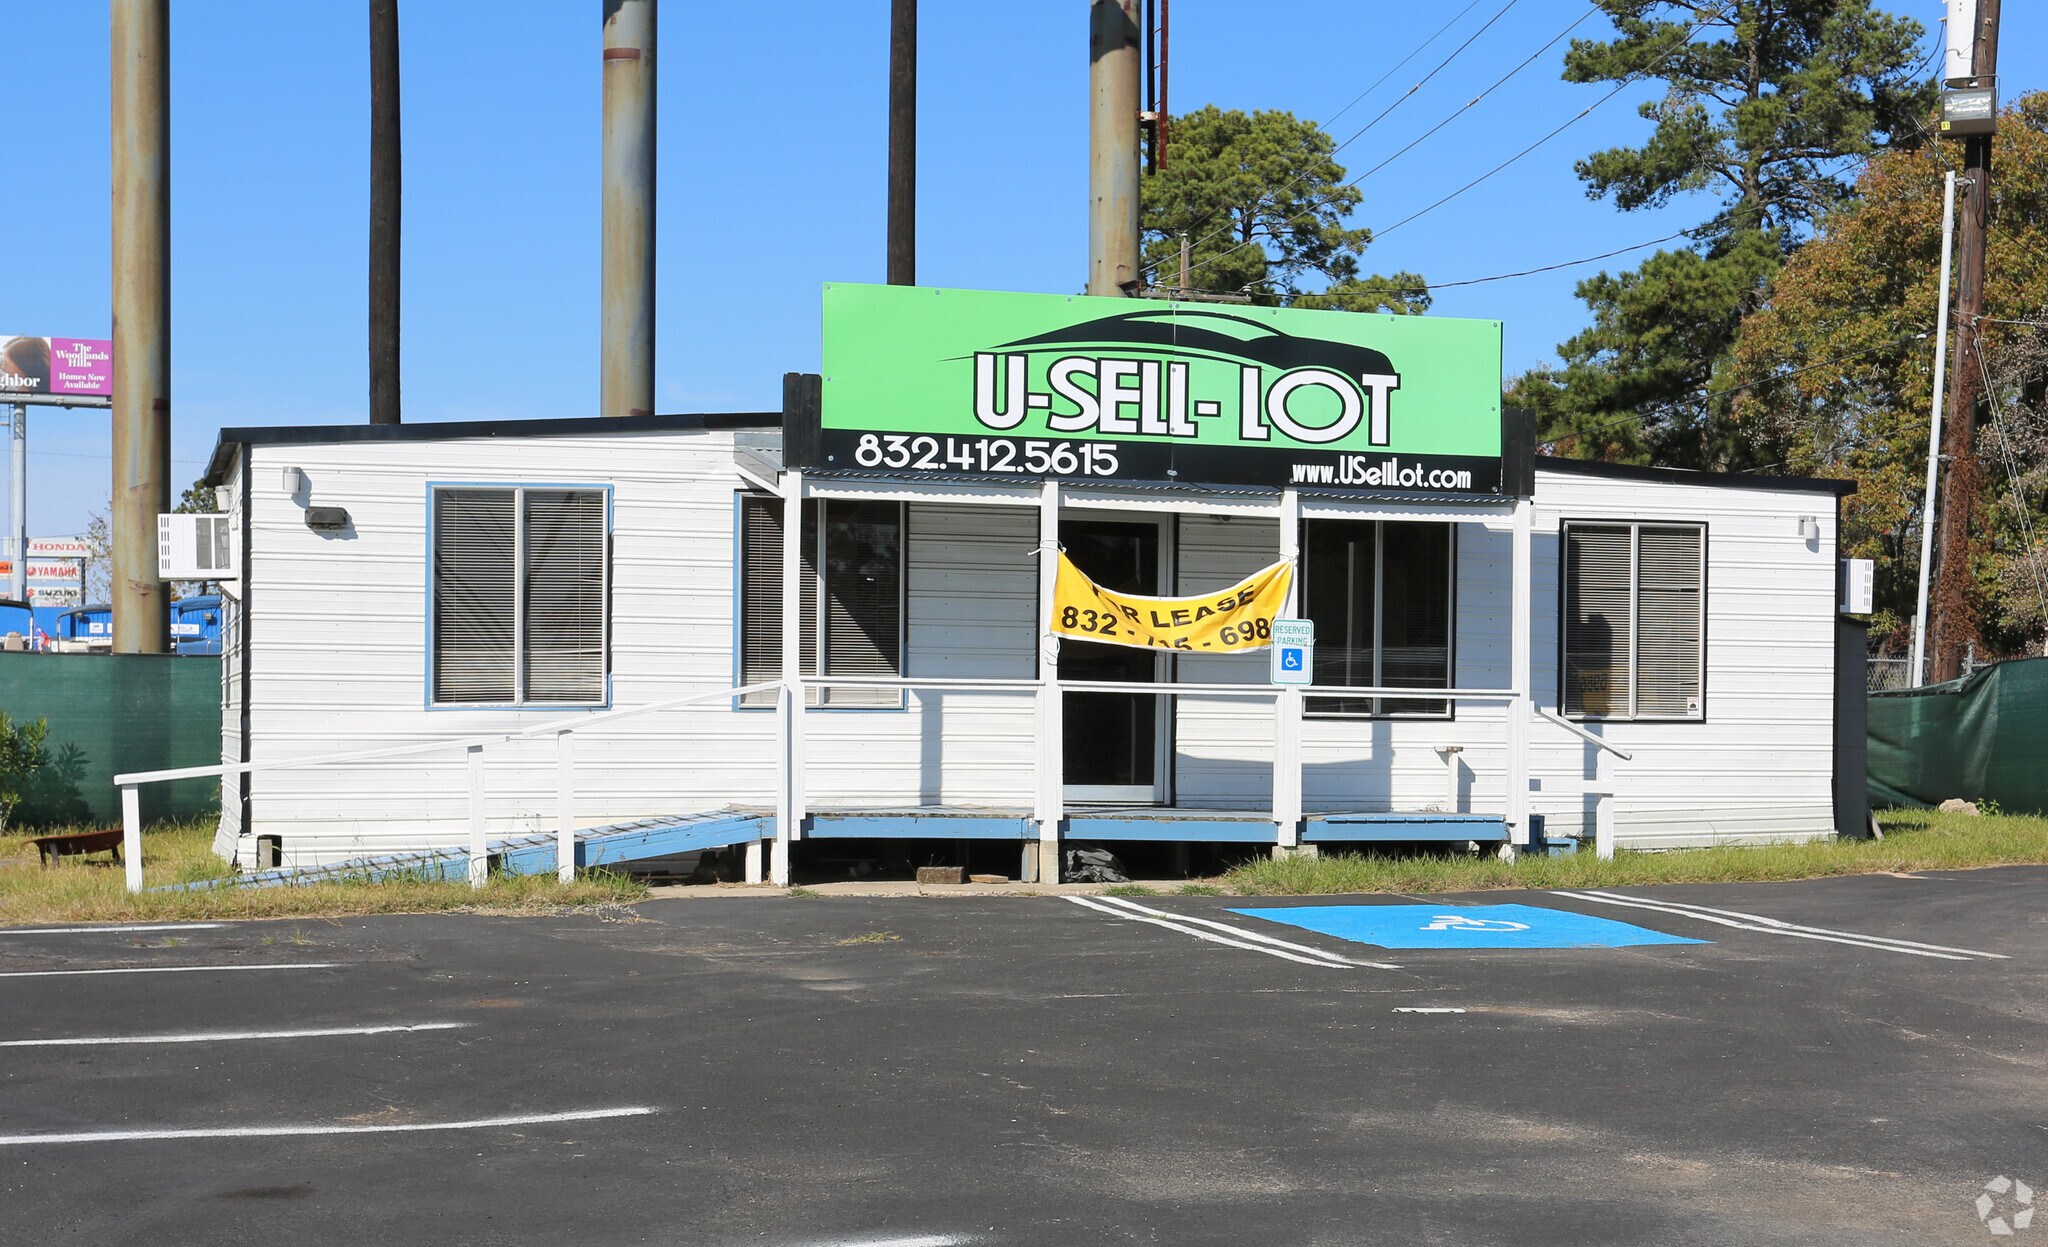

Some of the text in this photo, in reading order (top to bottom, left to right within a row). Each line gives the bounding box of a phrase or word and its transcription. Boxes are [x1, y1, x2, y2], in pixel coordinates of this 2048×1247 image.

[72, 343, 92, 352] The
[56, 350, 109, 360] Woodlands
[68, 359, 92, 367] Hills
[64, 381, 100, 389] Available
[855, 434, 1118, 475] 832.412.5615
[1292, 455, 1472, 489] www.USellLot.com
[38, 567, 77, 577] YAMAHA
[38, 589, 77, 597] SUZUKI
[1150, 584, 1255, 628] LEASE
[1061, 606, 1118, 636] 832
[1220, 616, 1275, 646] 698
[1275, 625, 1310, 635] RESERVED
[1277, 637, 1308, 647] PARKING
